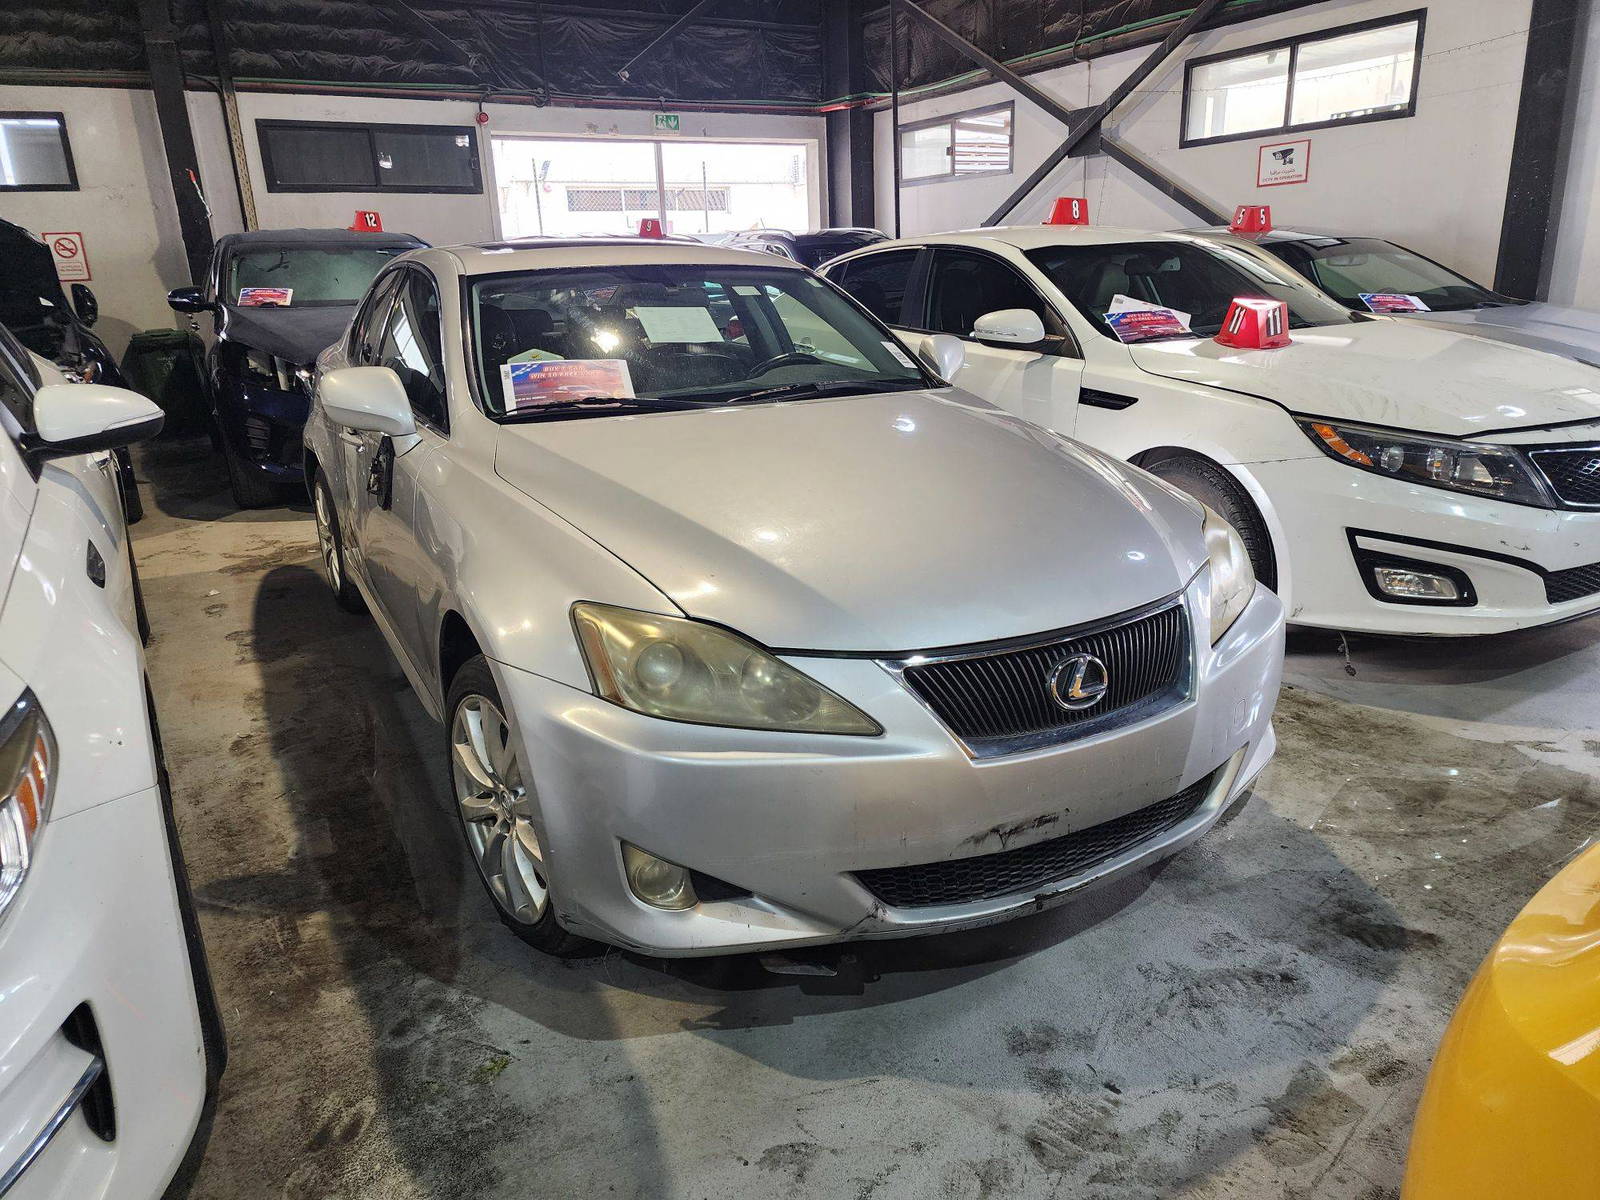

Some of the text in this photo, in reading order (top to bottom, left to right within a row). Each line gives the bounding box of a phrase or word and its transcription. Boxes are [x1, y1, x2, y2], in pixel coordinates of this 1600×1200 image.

[1072, 199, 1080, 219] 8
[1237, 208, 1246, 225] 5
[1260, 208, 1266, 225] 5
[365, 213, 377, 227] 12
[646, 220, 652, 232] 9
[1228, 306, 1247, 335] 11
[1266, 306, 1282, 336] 11
